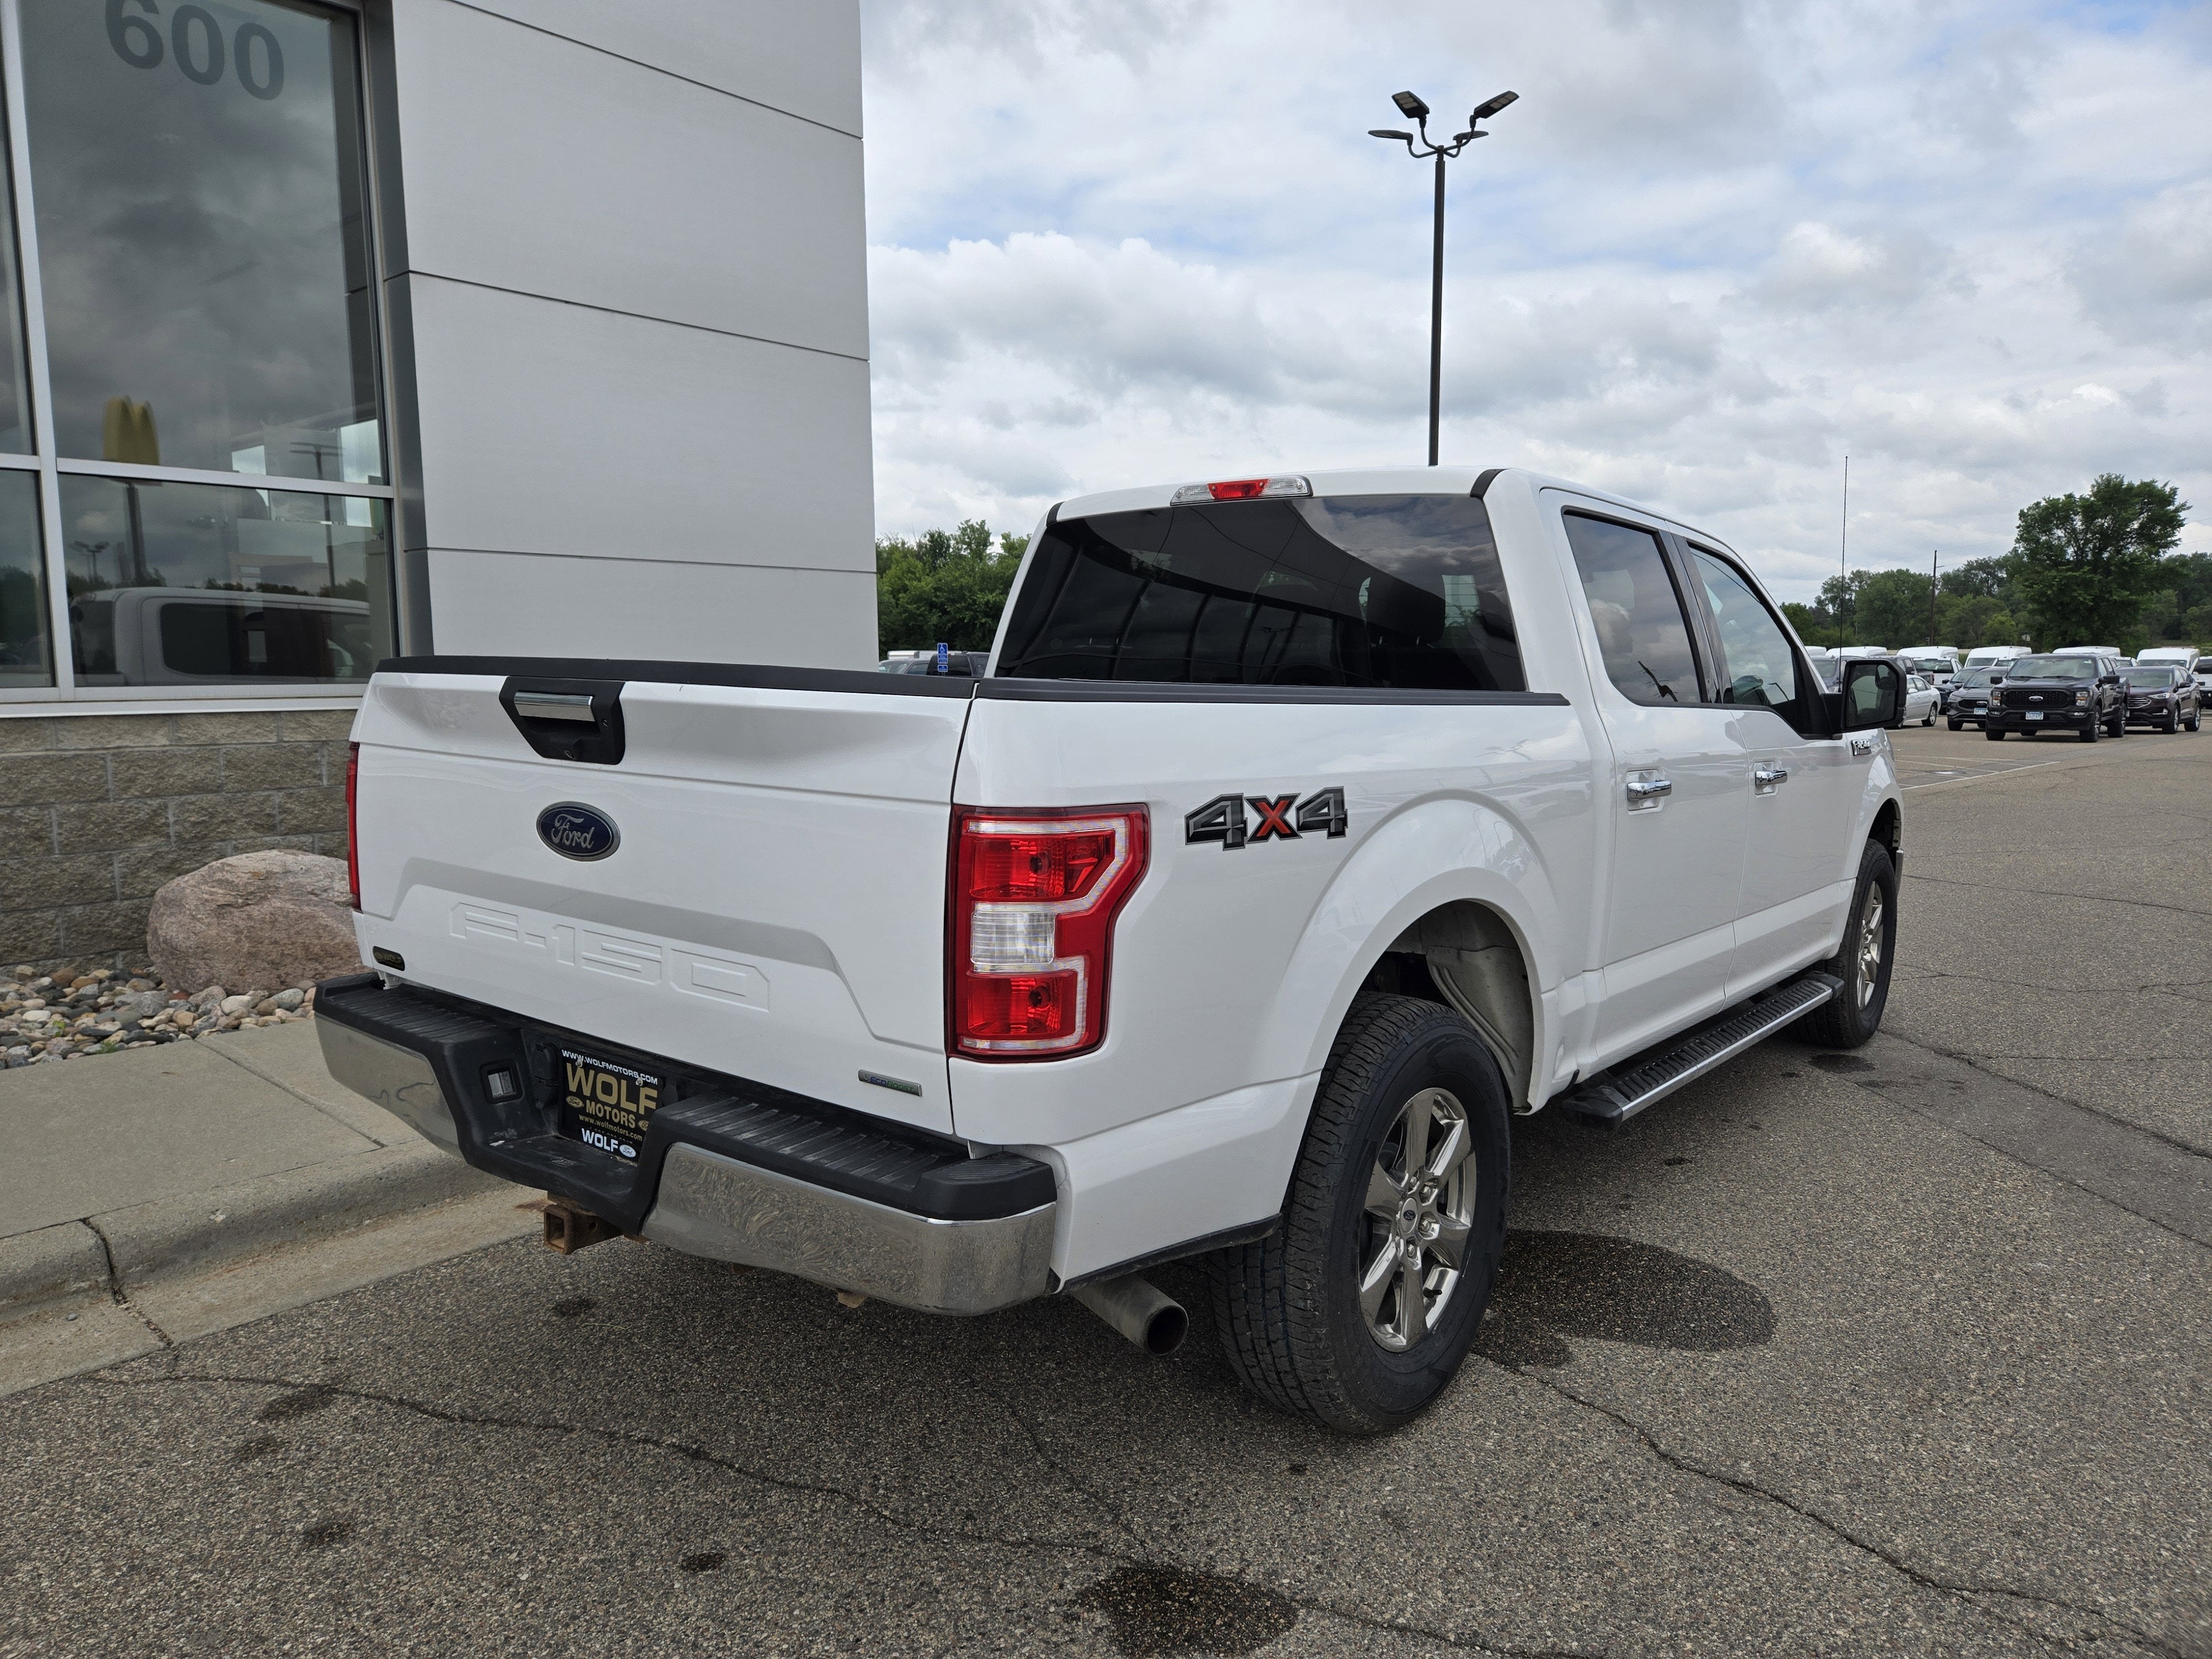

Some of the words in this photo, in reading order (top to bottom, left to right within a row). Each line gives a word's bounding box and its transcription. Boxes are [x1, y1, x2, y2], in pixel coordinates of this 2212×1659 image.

[105, 0, 284, 101] 600
[551, 813, 596, 849] Ford
[448, 902, 770, 1013] F-150
[566, 1063, 658, 1115] WOLF
[568, 1096, 582, 1107] Ford
[586, 1099, 636, 1129] MOTORS
[578, 1114, 643, 1142] www.wolfmotors.com
[581, 1128, 619, 1152] WOLF
